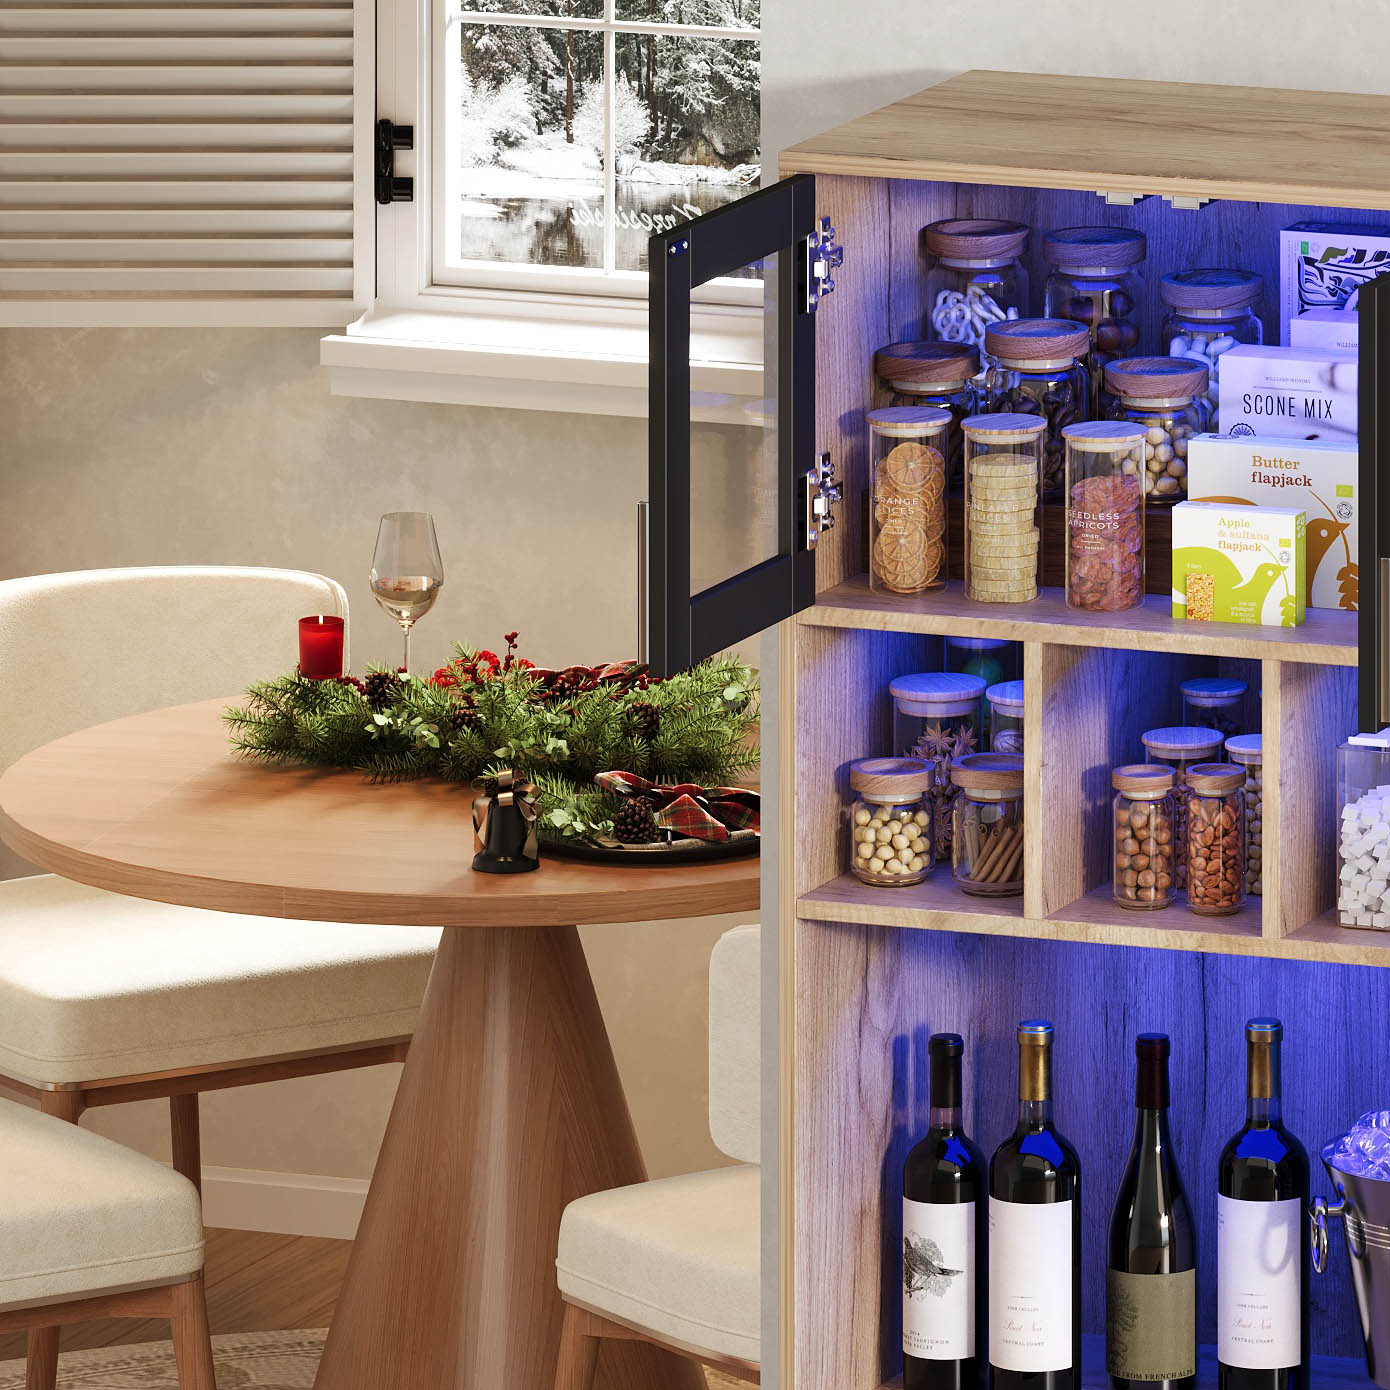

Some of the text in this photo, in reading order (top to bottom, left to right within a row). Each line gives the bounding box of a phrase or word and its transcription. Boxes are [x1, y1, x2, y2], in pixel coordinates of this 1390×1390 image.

[1242, 393, 1333, 420] SCONE MIX
[1251, 455, 1300, 470] Butter
[1251, 472, 1313, 488] flapjack
[874, 495, 919, 505] ORANGE
[882, 506, 915, 515] LICES
[1068, 510, 1121, 520] SEEDLESS
[1068, 520, 1120, 530] APRICOTS
[1217, 517, 1251, 529] Apple
[1230, 530, 1270, 540] sultana
[1218, 540, 1262, 552] flapjack
[1122, 1371, 1143, 1380] FROM
[1145, 1372, 1177, 1381] FRENCH
[1178, 1369, 1193, 1377] ALPS
